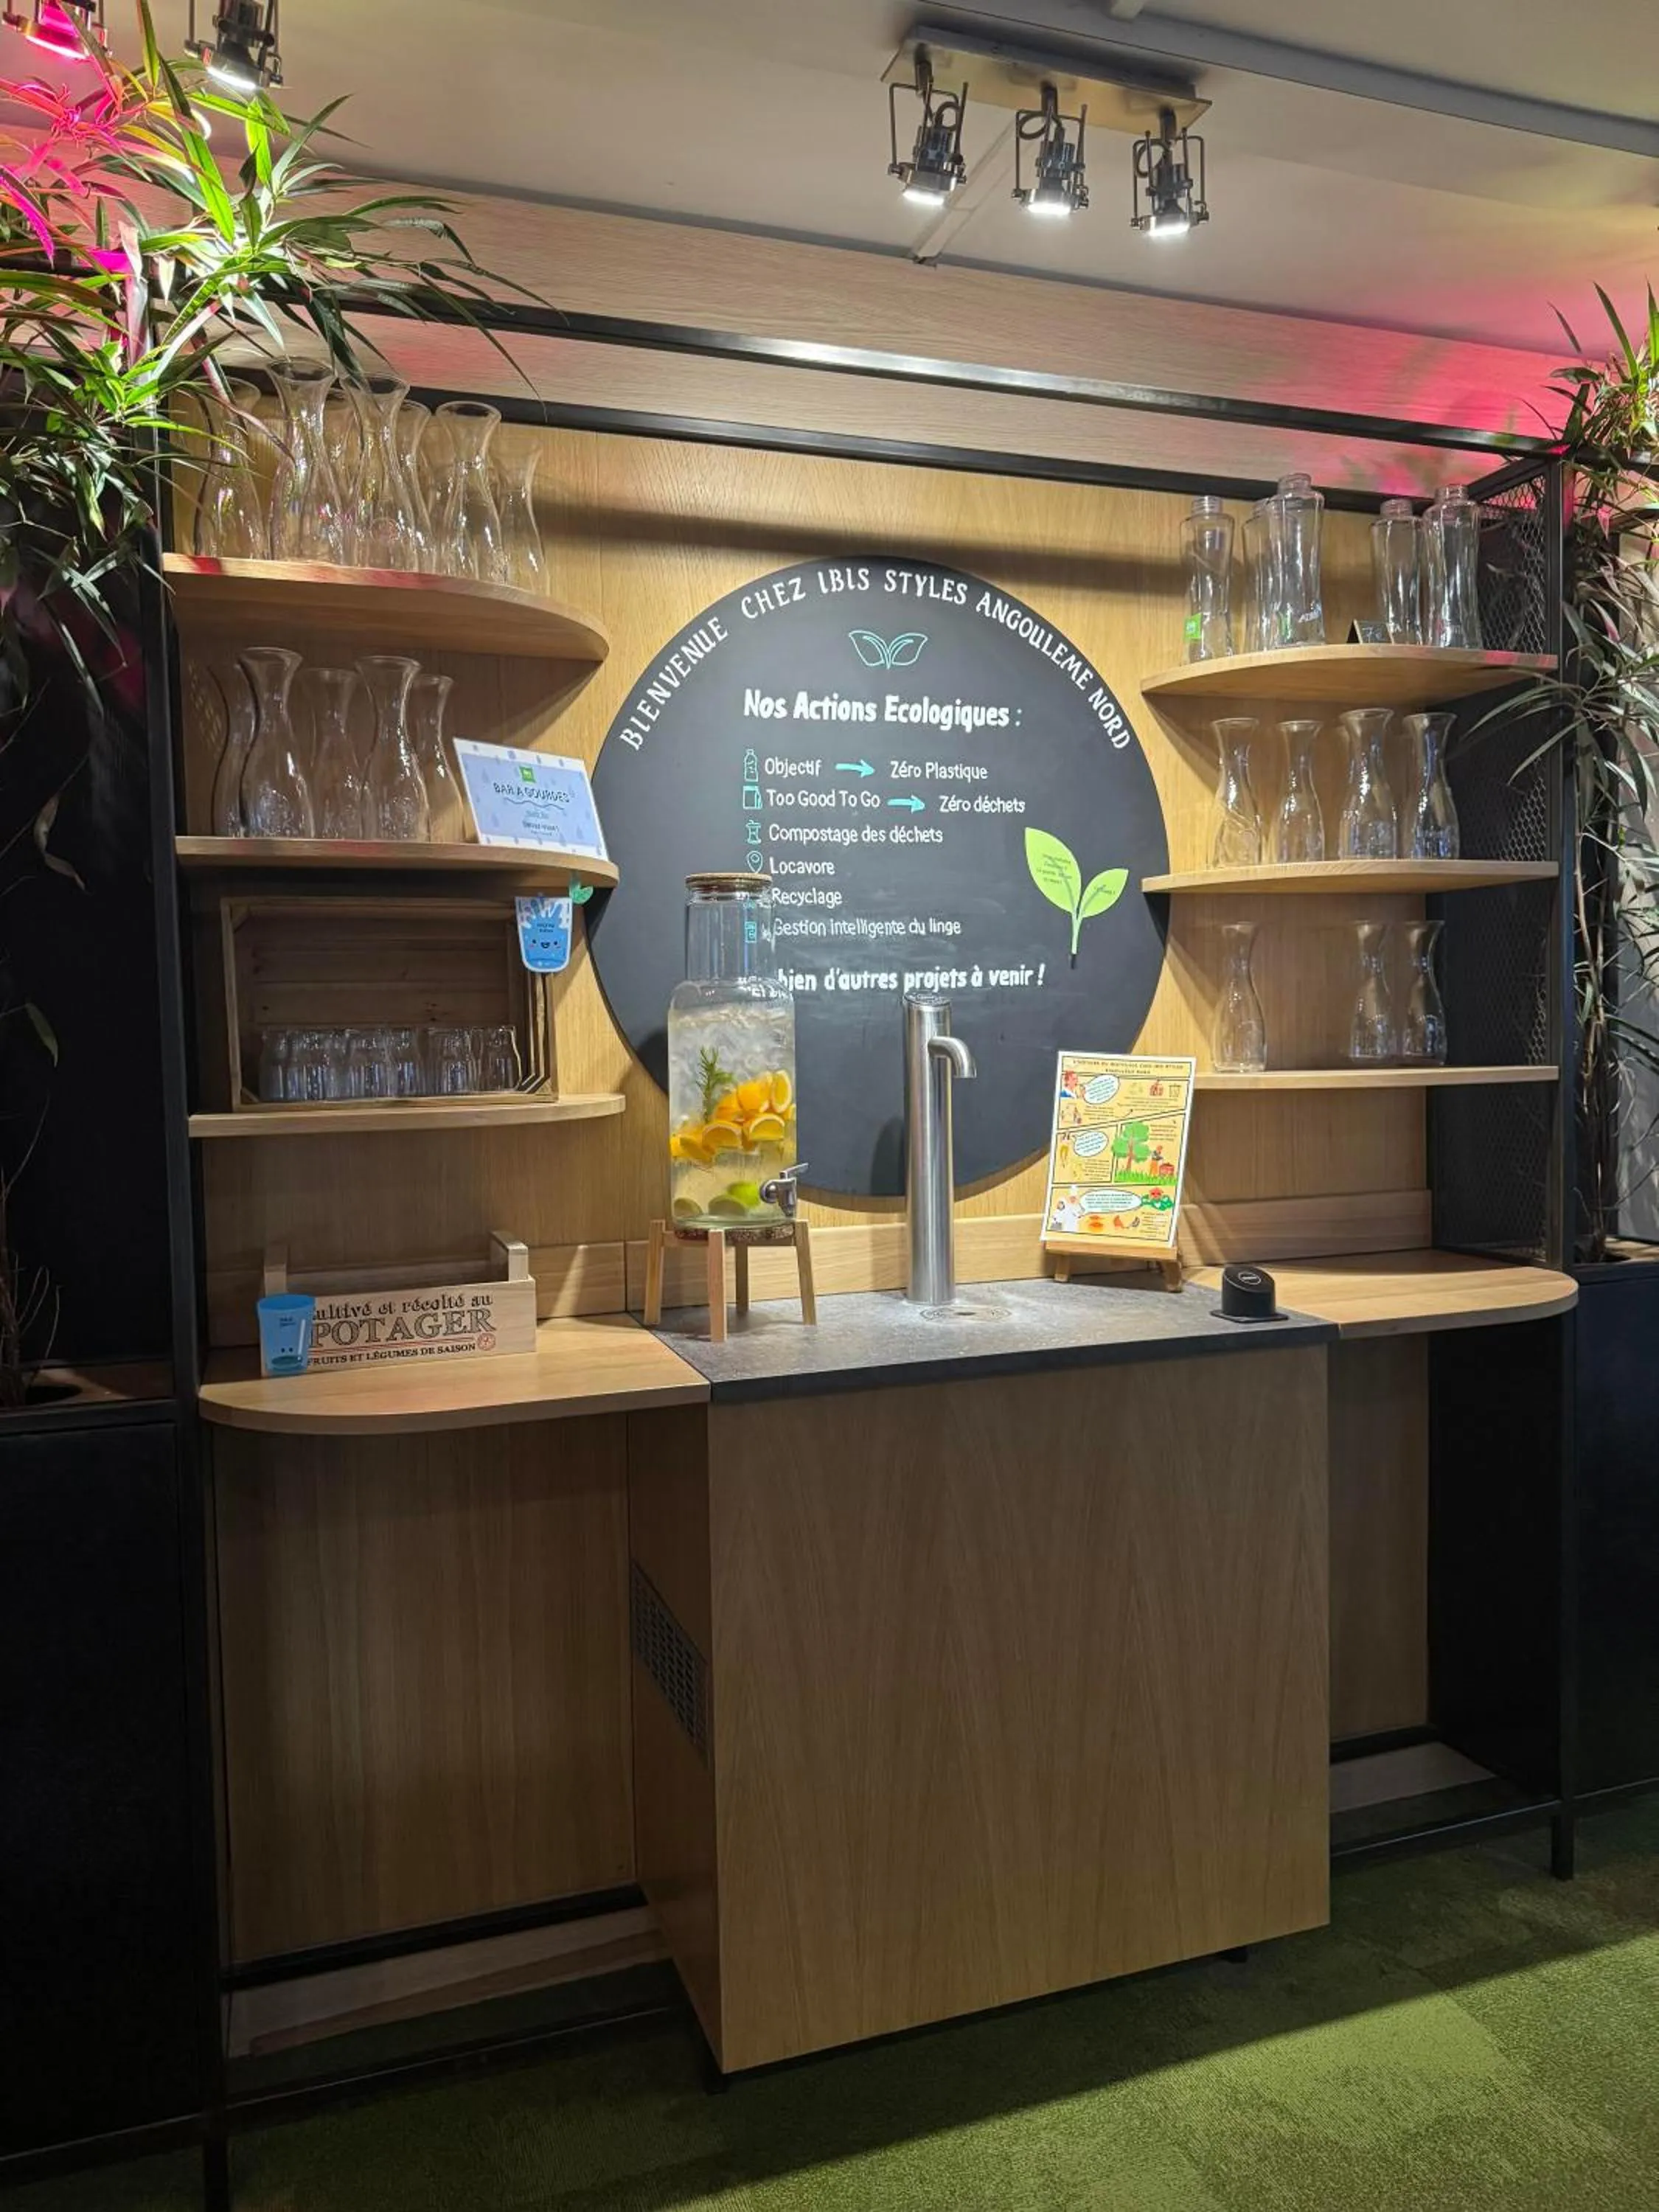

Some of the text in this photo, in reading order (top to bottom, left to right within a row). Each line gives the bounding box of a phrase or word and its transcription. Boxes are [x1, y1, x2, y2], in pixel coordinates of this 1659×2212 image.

[619, 568, 1130, 751] BIENVENUE CHEZ IBIS STYLES ANGOULEME NORD
[742, 688, 788, 720] Nos
[792, 690, 878, 723] Actions
[883, 694, 1010, 734] Ecologiques
[764, 756, 989, 783] Objectif Zéro Plastique
[765, 788, 1026, 813] Too Good To Go Zéro déchets
[768, 823, 944, 846] Compostage des déchets
[770, 856, 835, 876] Locavore
[772, 887, 843, 909] Recyclage
[774, 917, 961, 939] Gestion intelligente du linge
[824, 967, 899, 992] d'autres
[903, 965, 967, 993] projets
[970, 964, 984, 987] à
[988, 963, 1033, 987] venir
[313, 1294, 493, 1320] ultivé et récolté au
[310, 1308, 496, 1348] POTAGER
[350, 1353, 364, 1363] ET
[421, 1346, 436, 1357] DE
[437, 1342, 476, 1355] SAISON
